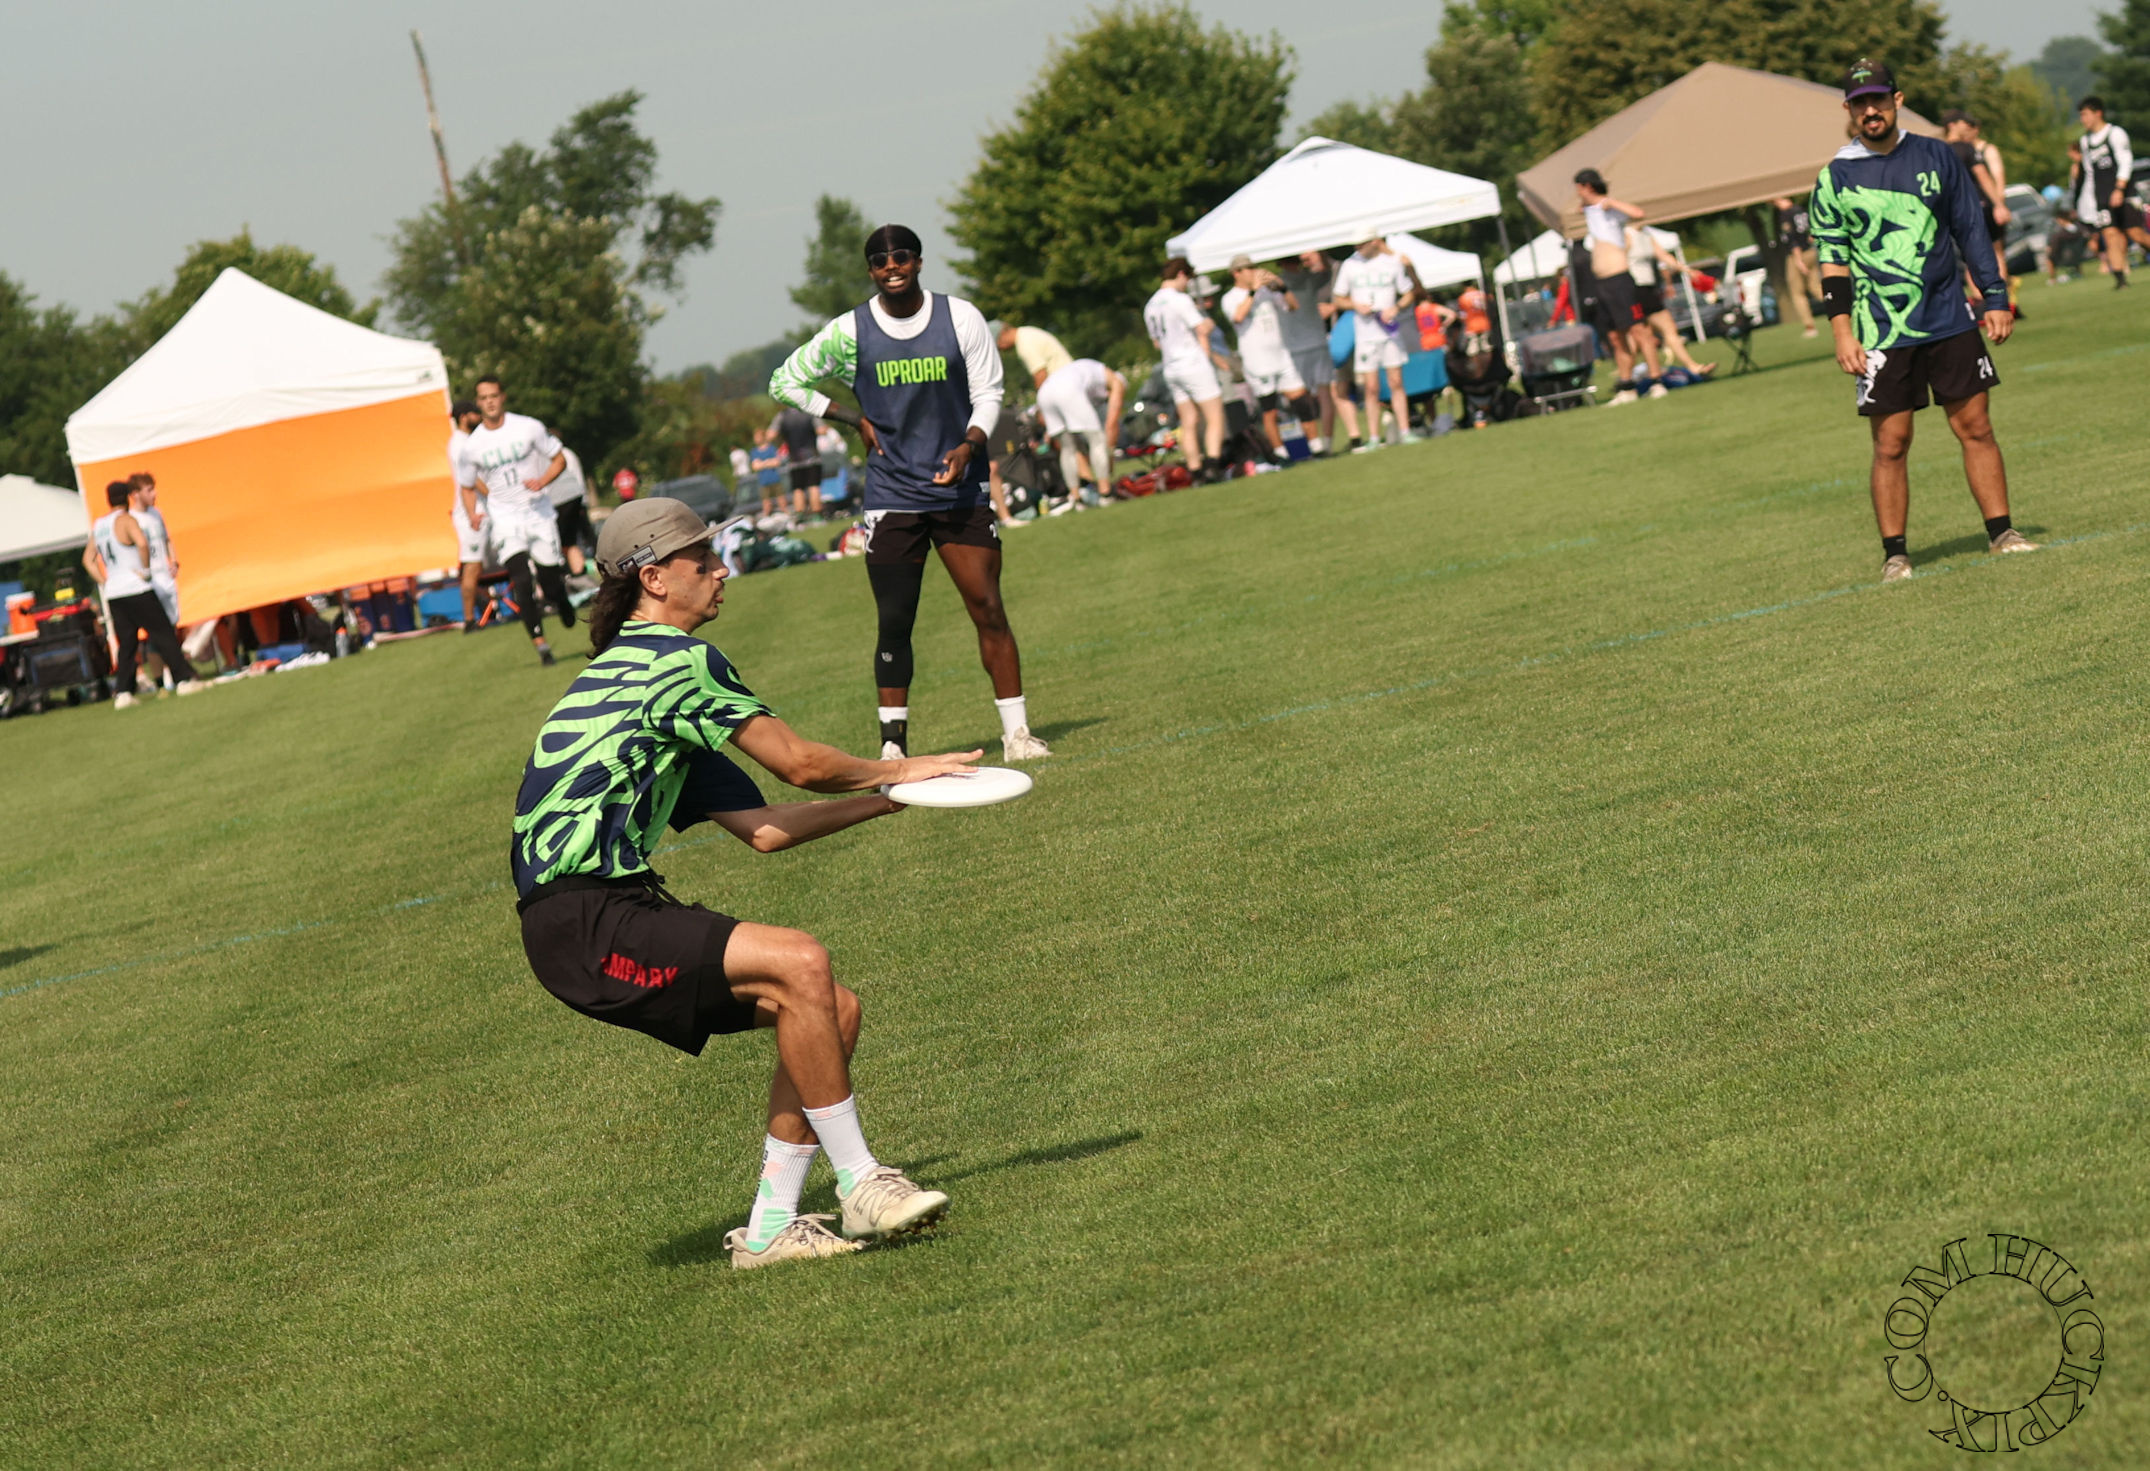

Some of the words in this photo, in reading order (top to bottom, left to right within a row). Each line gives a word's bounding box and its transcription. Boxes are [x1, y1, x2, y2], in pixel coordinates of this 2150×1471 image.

[1916, 170, 1941, 197] 24
[875, 355, 947, 387] UPROAR
[1977, 355, 1993, 379] 24
